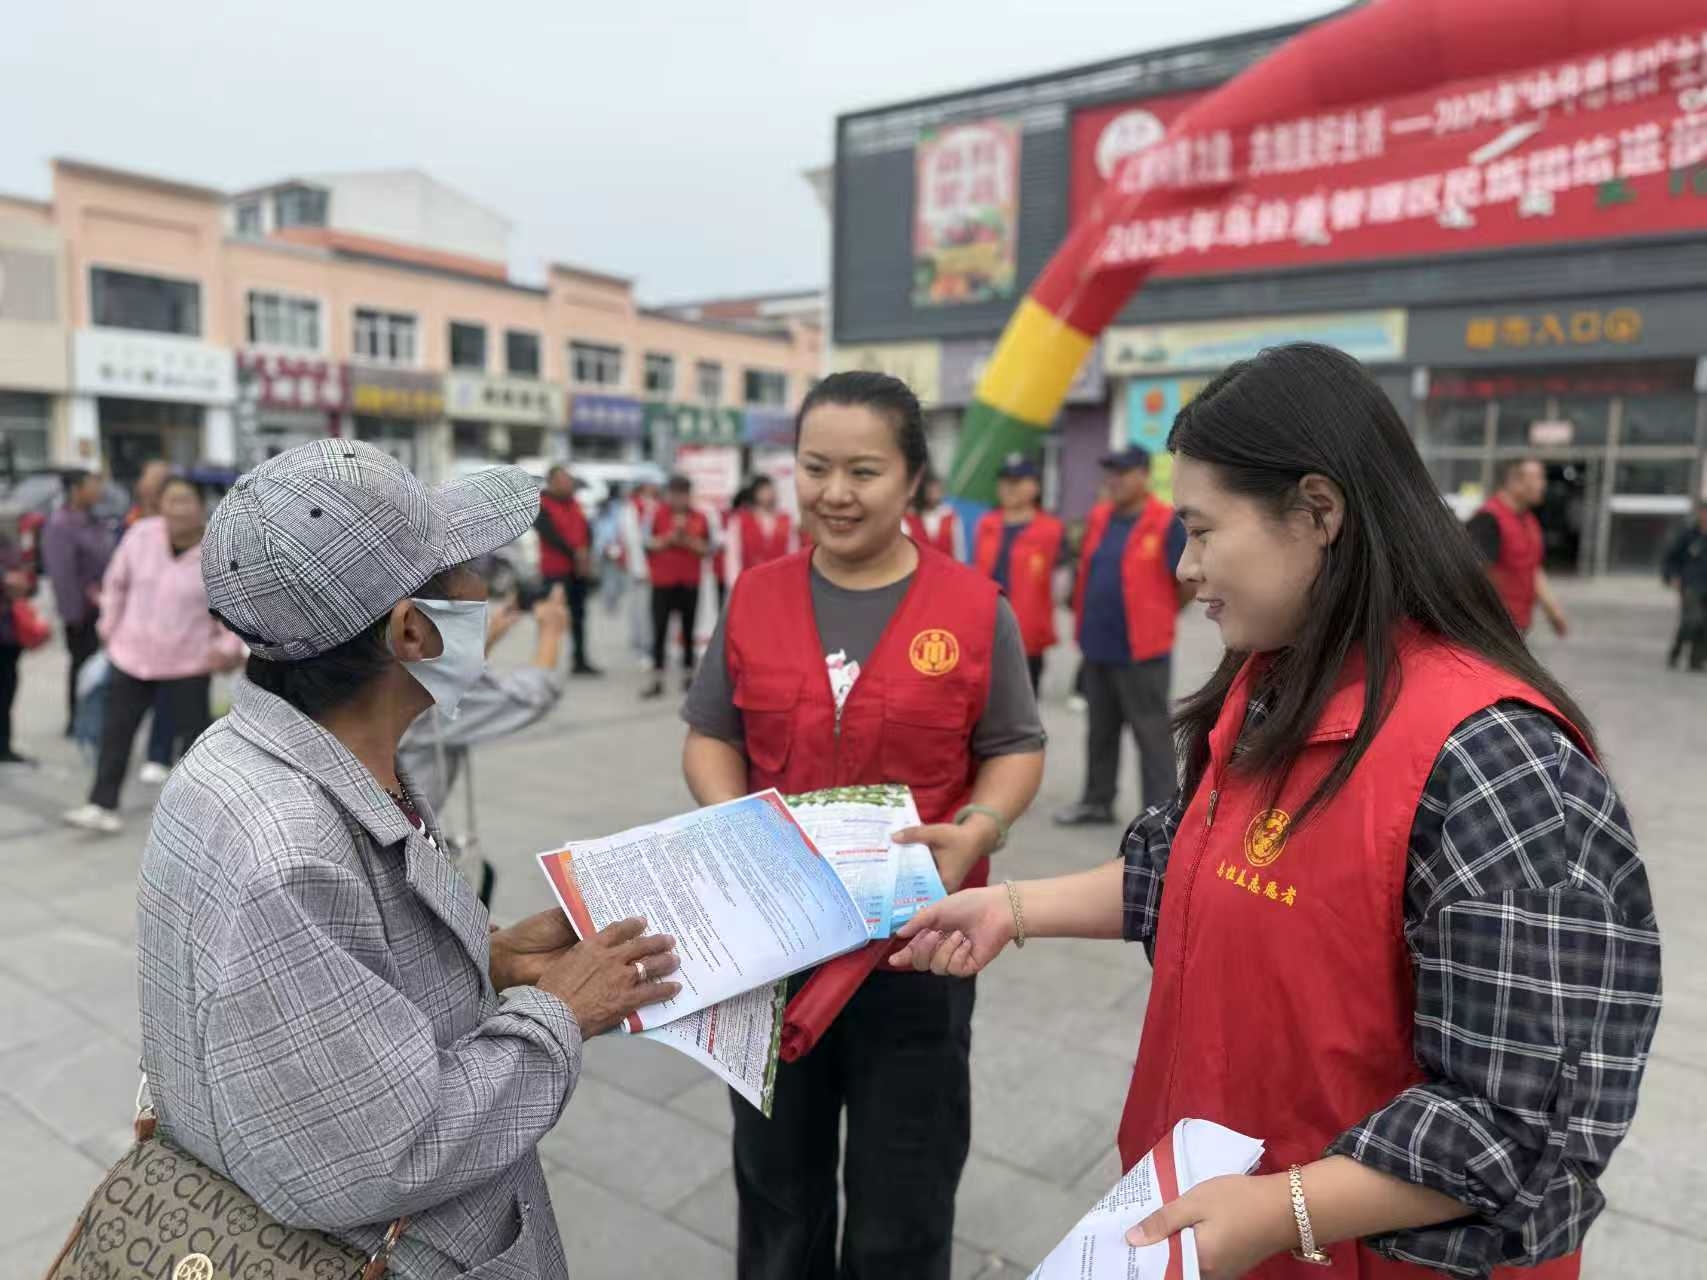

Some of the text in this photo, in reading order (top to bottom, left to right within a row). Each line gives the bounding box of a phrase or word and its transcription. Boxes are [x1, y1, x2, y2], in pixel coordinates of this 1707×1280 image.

[105, 1176, 165, 1227] CLN
[174, 1173, 234, 1220] CLN
[257, 1222, 321, 1271] CLN
